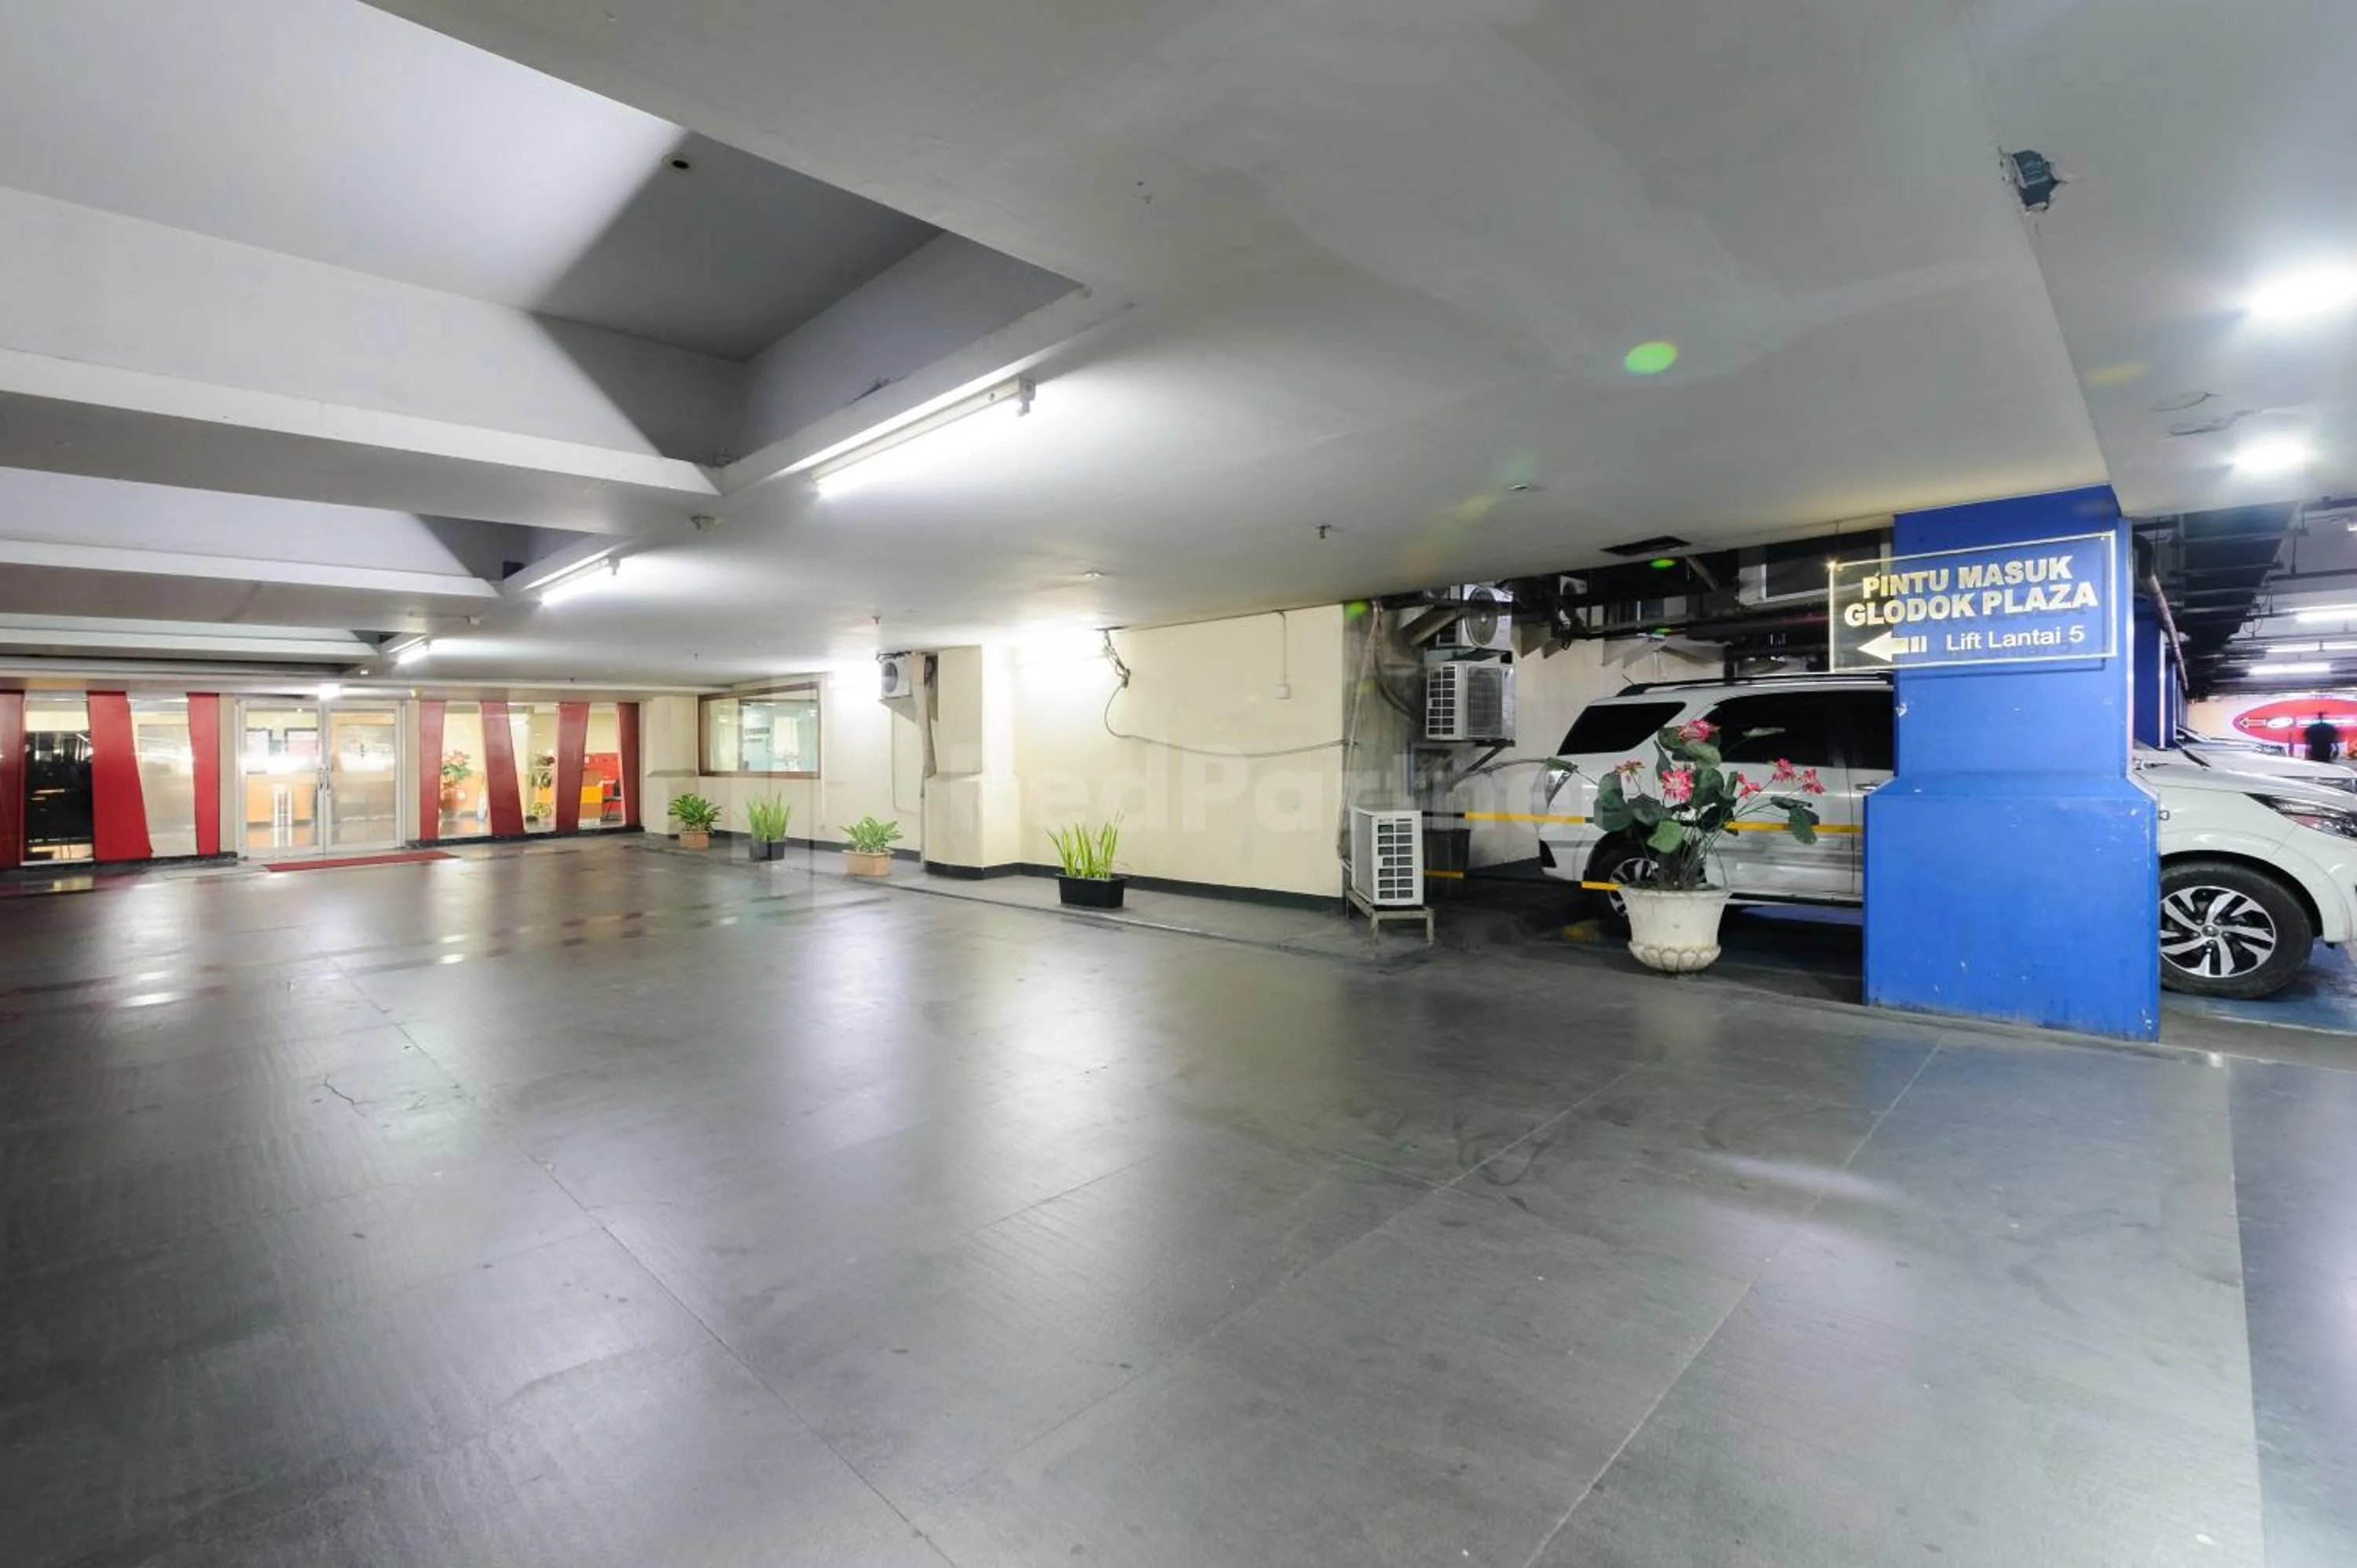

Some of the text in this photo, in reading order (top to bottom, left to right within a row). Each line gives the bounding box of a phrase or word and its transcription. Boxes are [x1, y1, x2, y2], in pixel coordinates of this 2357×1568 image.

[1863, 555, 2073, 599] PINTU MASUK
[1844, 581, 2098, 628] GLODOK PLAZA
[1946, 625, 2085, 651] Lift Lantai 5
